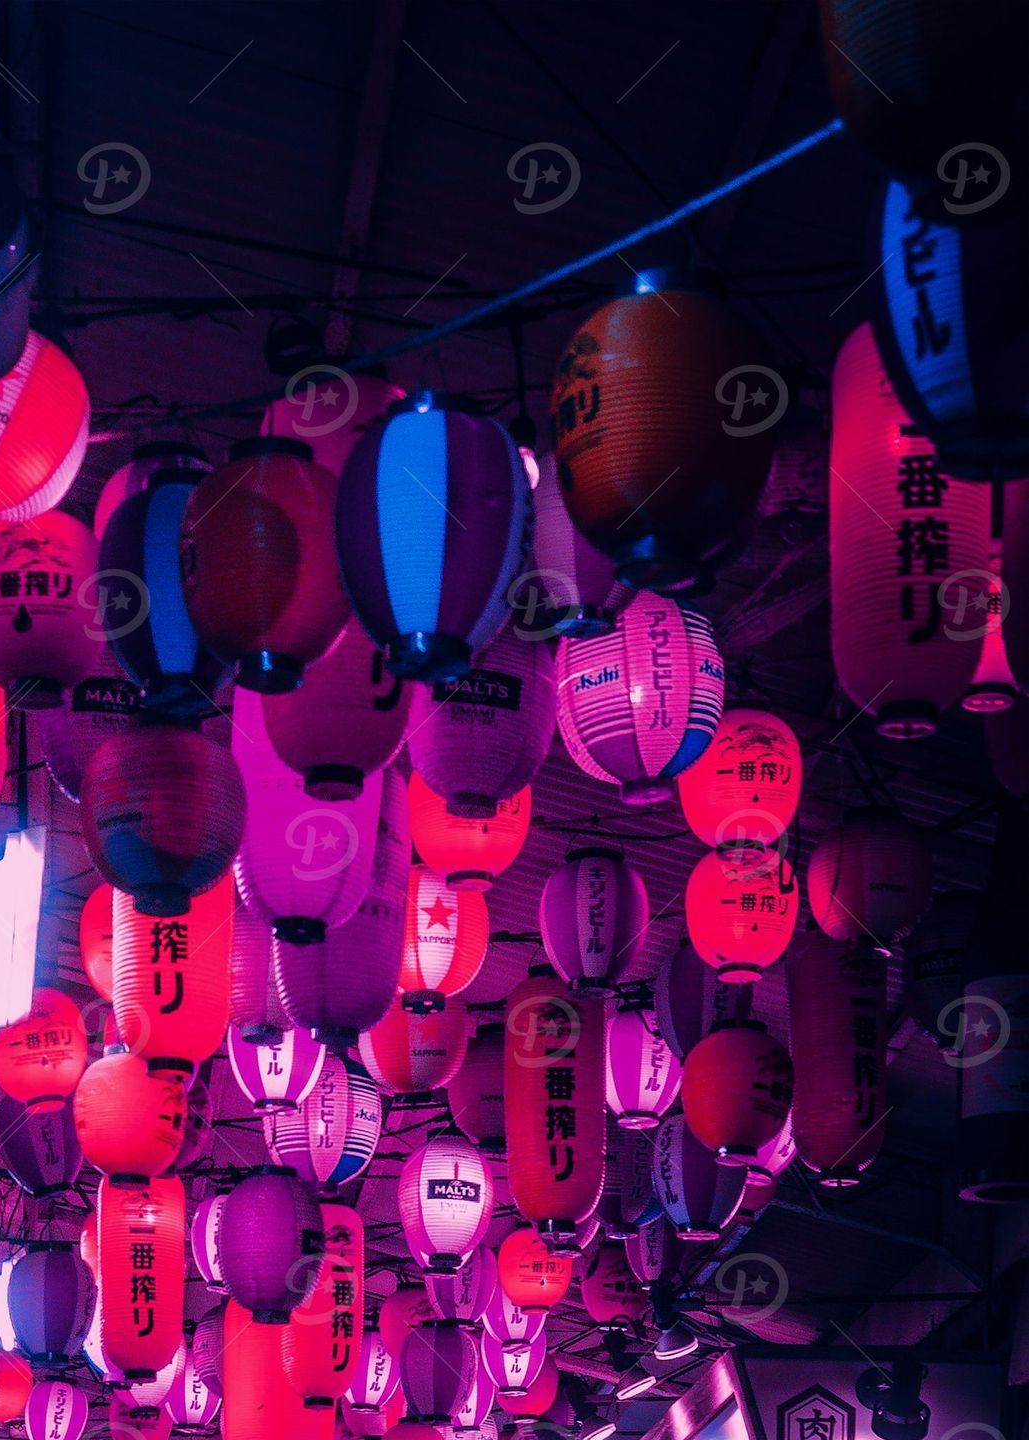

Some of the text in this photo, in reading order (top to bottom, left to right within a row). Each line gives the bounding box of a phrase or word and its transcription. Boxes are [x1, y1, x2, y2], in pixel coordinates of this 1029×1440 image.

[444, 679, 509, 699] MALT'S
[574, 668, 620, 691] Asahi
[646, 611, 674, 731] アサヒビール
[716, 760, 792, 785] 一番搾り
[587, 866, 606, 955] キリンビール
[720, 893, 790, 916] 一番搾り
[9, 1030, 72, 1049] 一番搾り
[318, 1070, 337, 1149] アサヒビール
[545, 1048, 576, 1182] 一番搾り
[435, 1184, 476, 1198] MALT'S
[130, 1226, 156, 1337] 一番搾り
[519, 1259, 565, 1274] 一番搾り
[332, 1266, 355, 1373] 一番搾り
[48, 1389, 68, 1440] キリンビール
